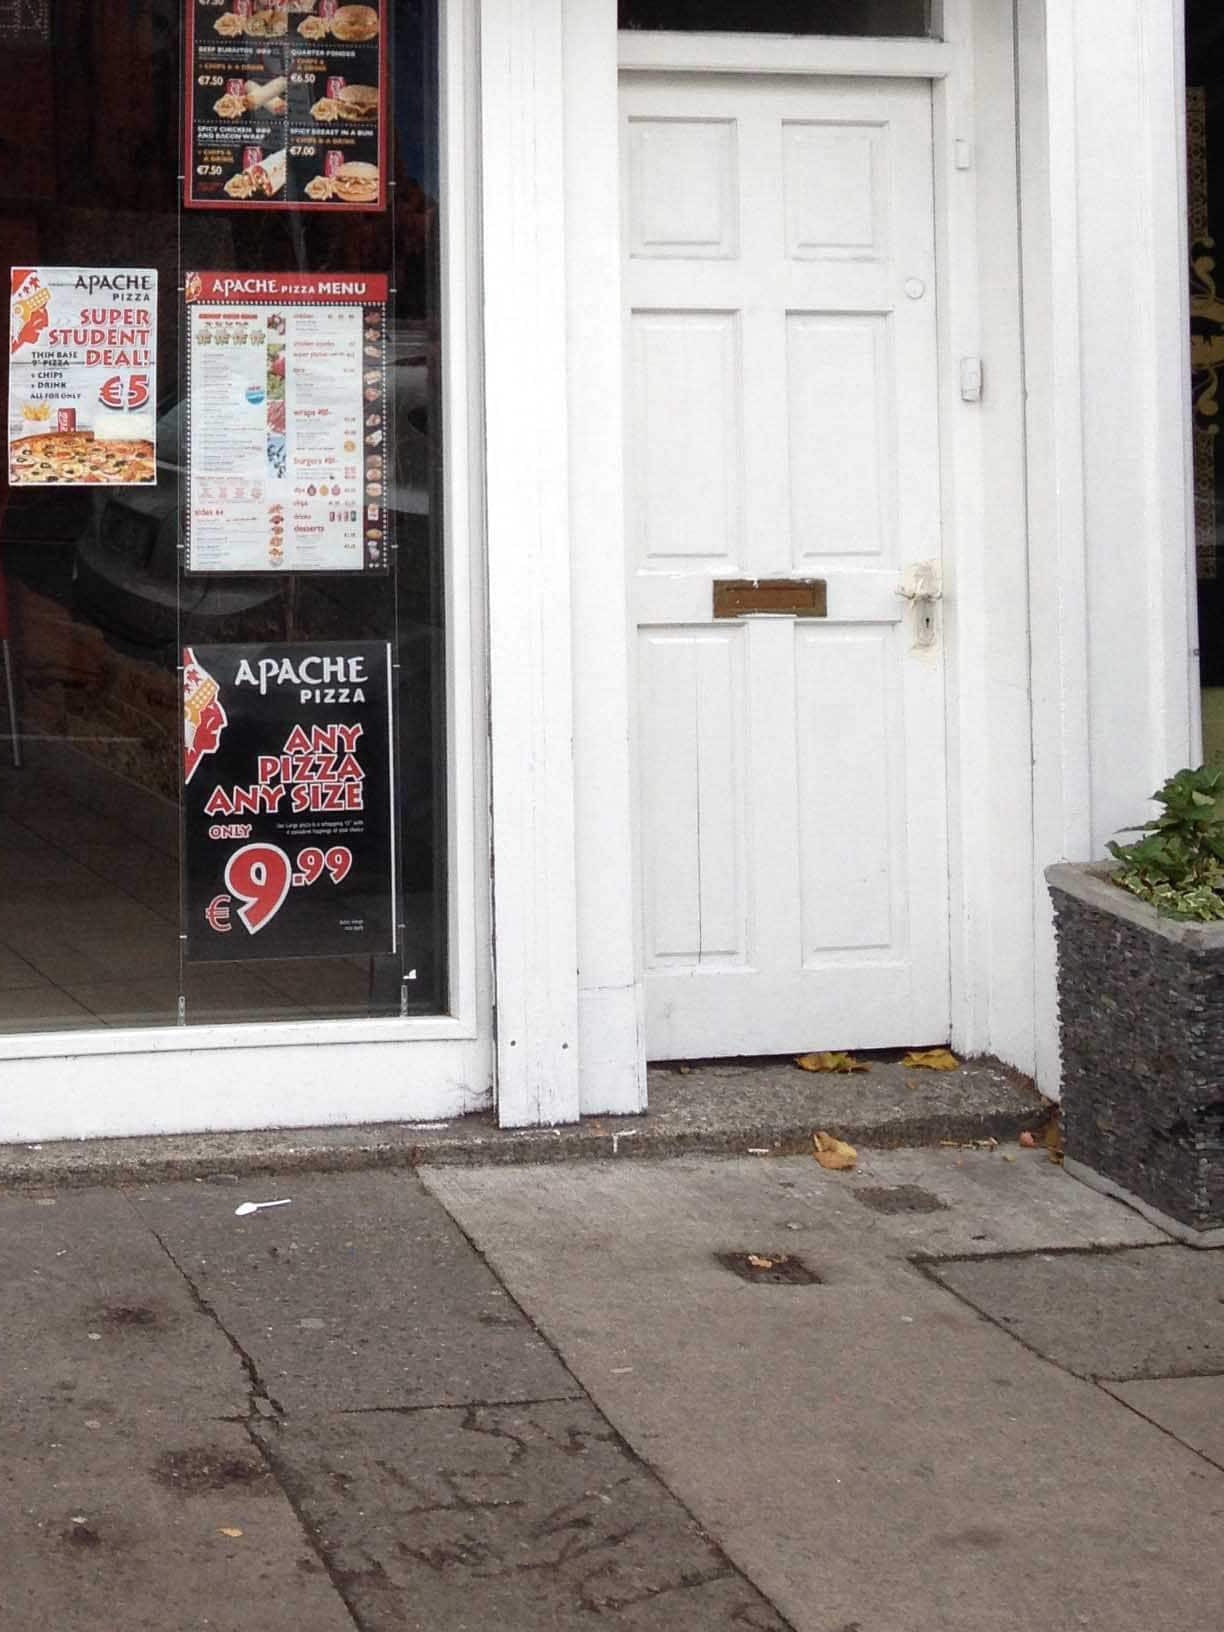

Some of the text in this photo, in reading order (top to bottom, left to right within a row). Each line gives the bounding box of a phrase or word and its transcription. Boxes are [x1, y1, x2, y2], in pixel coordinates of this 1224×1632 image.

[198, 75, 223, 86] €7.50
[290, 73, 316, 84] €6.50
[289, 146, 315, 156] €7.00
[196, 165, 222, 175] €7.50
[75, 275, 152, 295] APACHE
[212, 279, 366, 297] APACHE PIZZA MENU
[113, 293, 150, 301] PIZZA
[80, 309, 151, 325] SUPER
[48, 329, 150, 346] STUDENT
[85, 350, 150, 367] DEAL!
[99, 374, 150, 409] €5
[235, 657, 368, 695] APACHE
[300, 688, 366, 703] PIZZA
[283, 723, 363, 755] ANY
[258, 754, 365, 784] PIZZA
[204, 782, 364, 816] ANY SIZE
[209, 824, 253, 839] ONLY
[205, 842, 352, 935] €9.99
